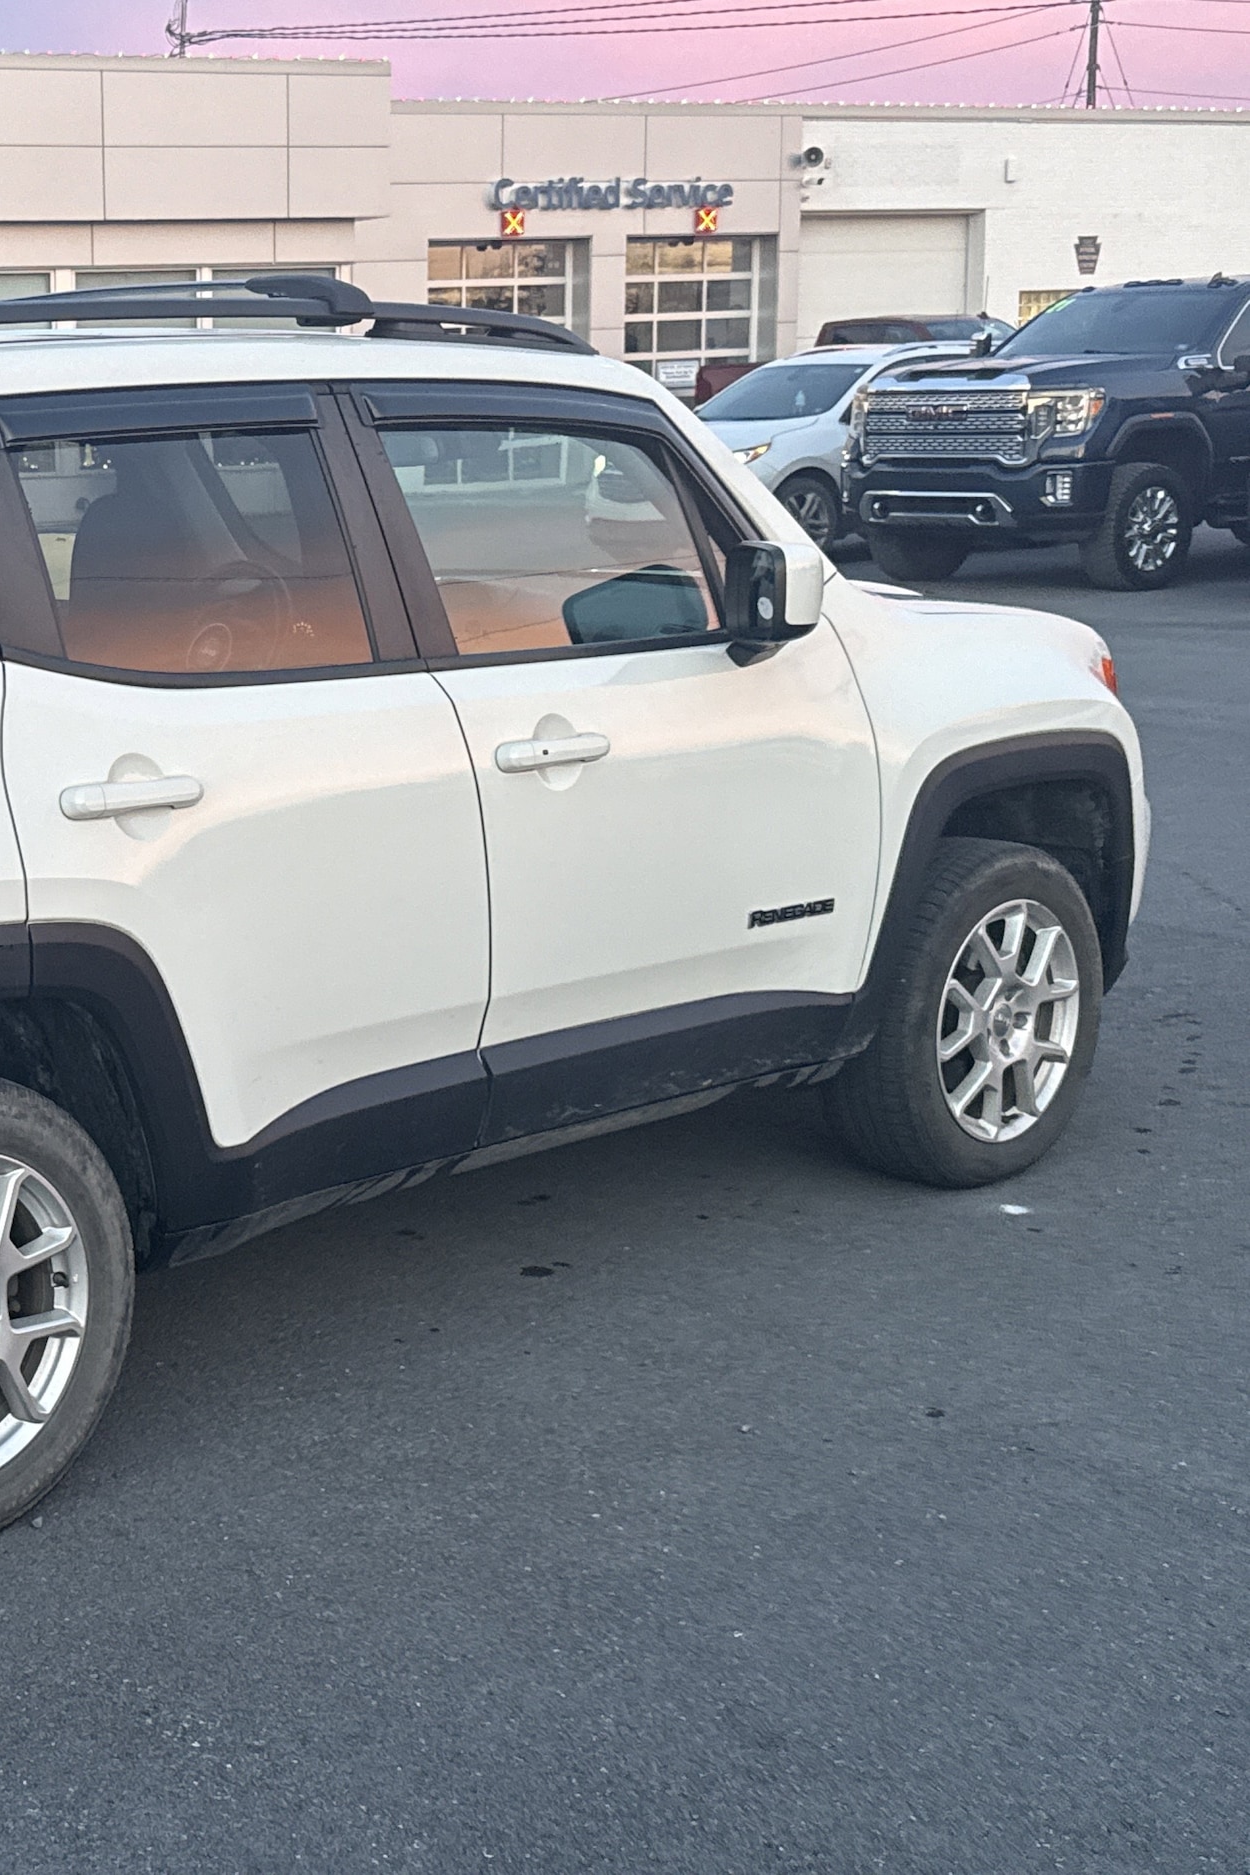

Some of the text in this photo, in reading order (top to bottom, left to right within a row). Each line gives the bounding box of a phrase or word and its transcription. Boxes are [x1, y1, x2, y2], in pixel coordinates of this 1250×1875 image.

[492, 177, 734, 210] Certified Service
[747, 898, 835, 930] RENEGADE
